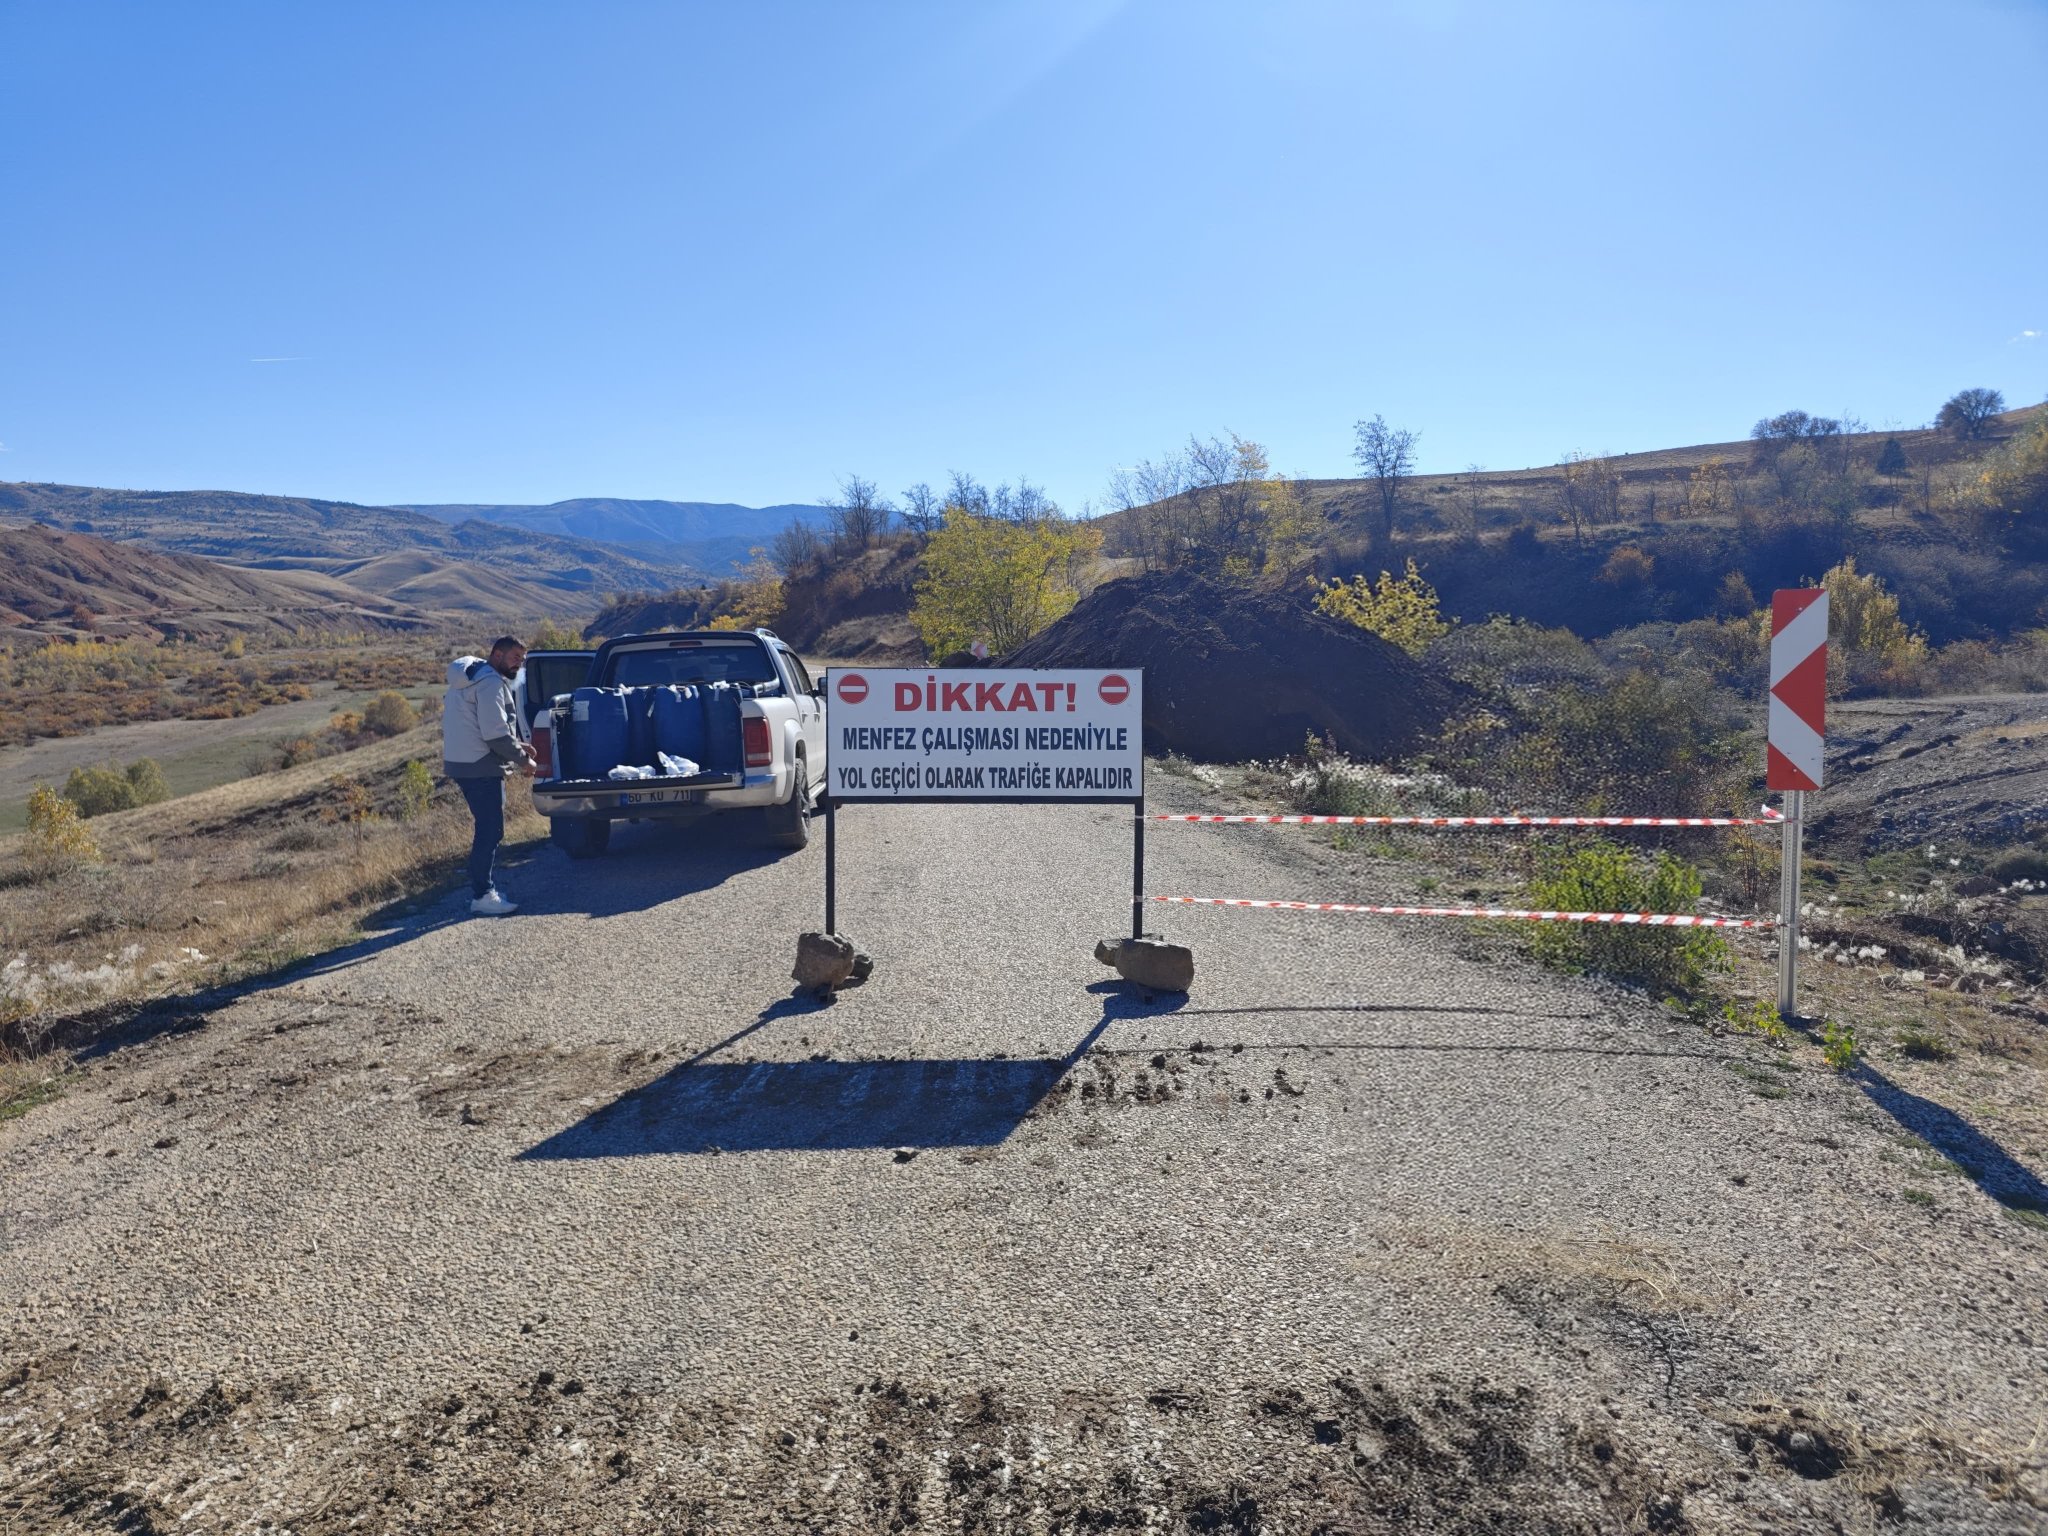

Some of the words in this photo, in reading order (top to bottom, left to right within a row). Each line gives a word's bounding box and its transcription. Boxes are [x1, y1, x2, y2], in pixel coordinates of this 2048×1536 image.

[895, 676, 1076, 712] DİKKAT!
[843, 727, 916, 750] MENFEZ
[922, 727, 1018, 756] ÇALIŞMASI
[1025, 722, 1127, 750] NEDENİYLE
[838, 767, 867, 789] YOL
[871, 762, 920, 794] GEÇİCİ
[925, 767, 984, 789] OLARAK
[988, 762, 1050, 789] TRAFİĞE
[1056, 767, 1132, 789] KAPALIDIR
